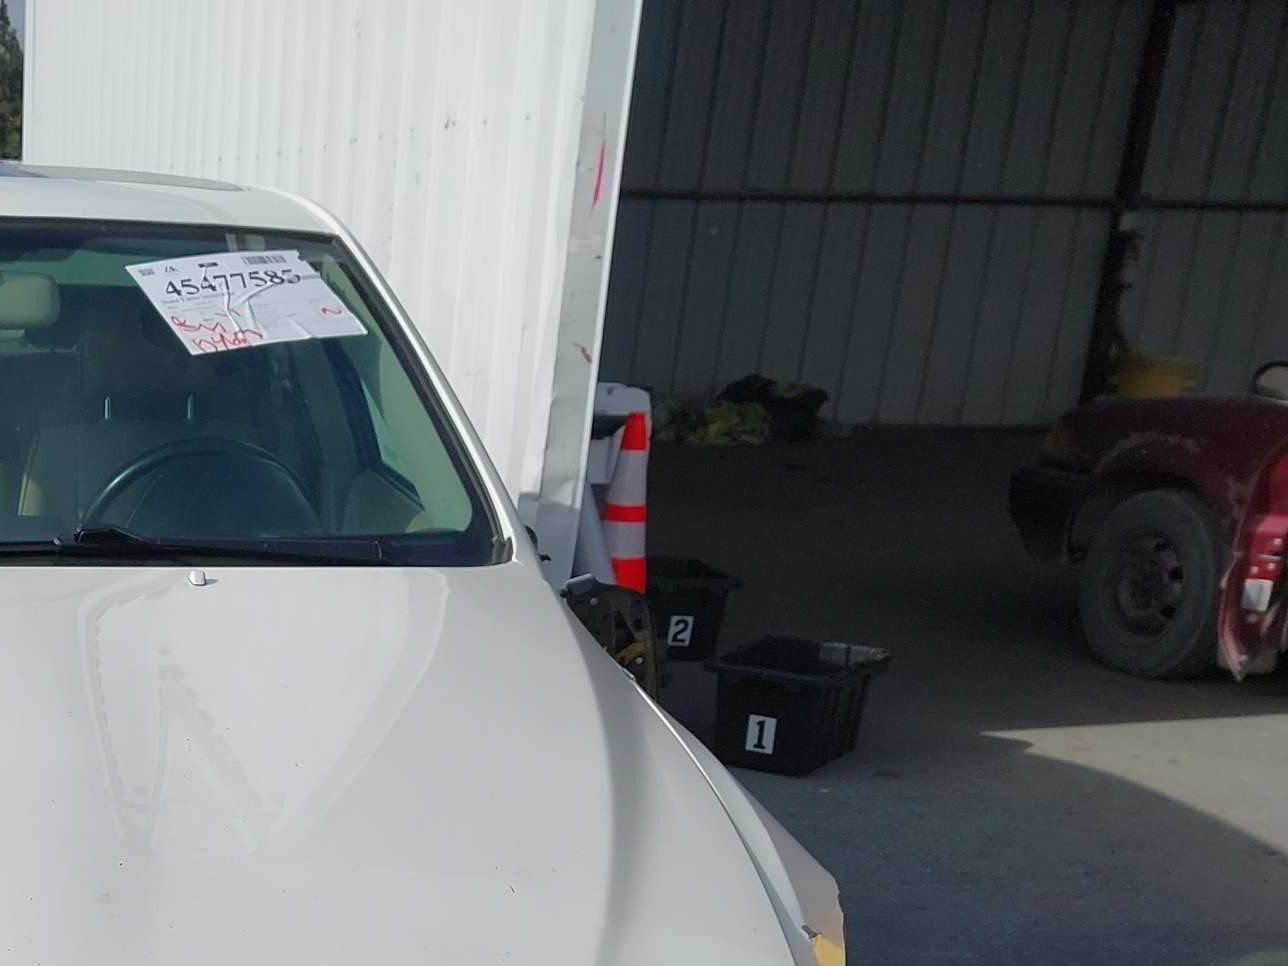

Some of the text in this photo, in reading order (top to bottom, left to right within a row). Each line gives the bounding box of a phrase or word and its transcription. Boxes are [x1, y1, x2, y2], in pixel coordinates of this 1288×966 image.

[165, 269, 300, 296] 45477585
[672, 618, 690, 643] 2
[752, 720, 767, 750] 1
